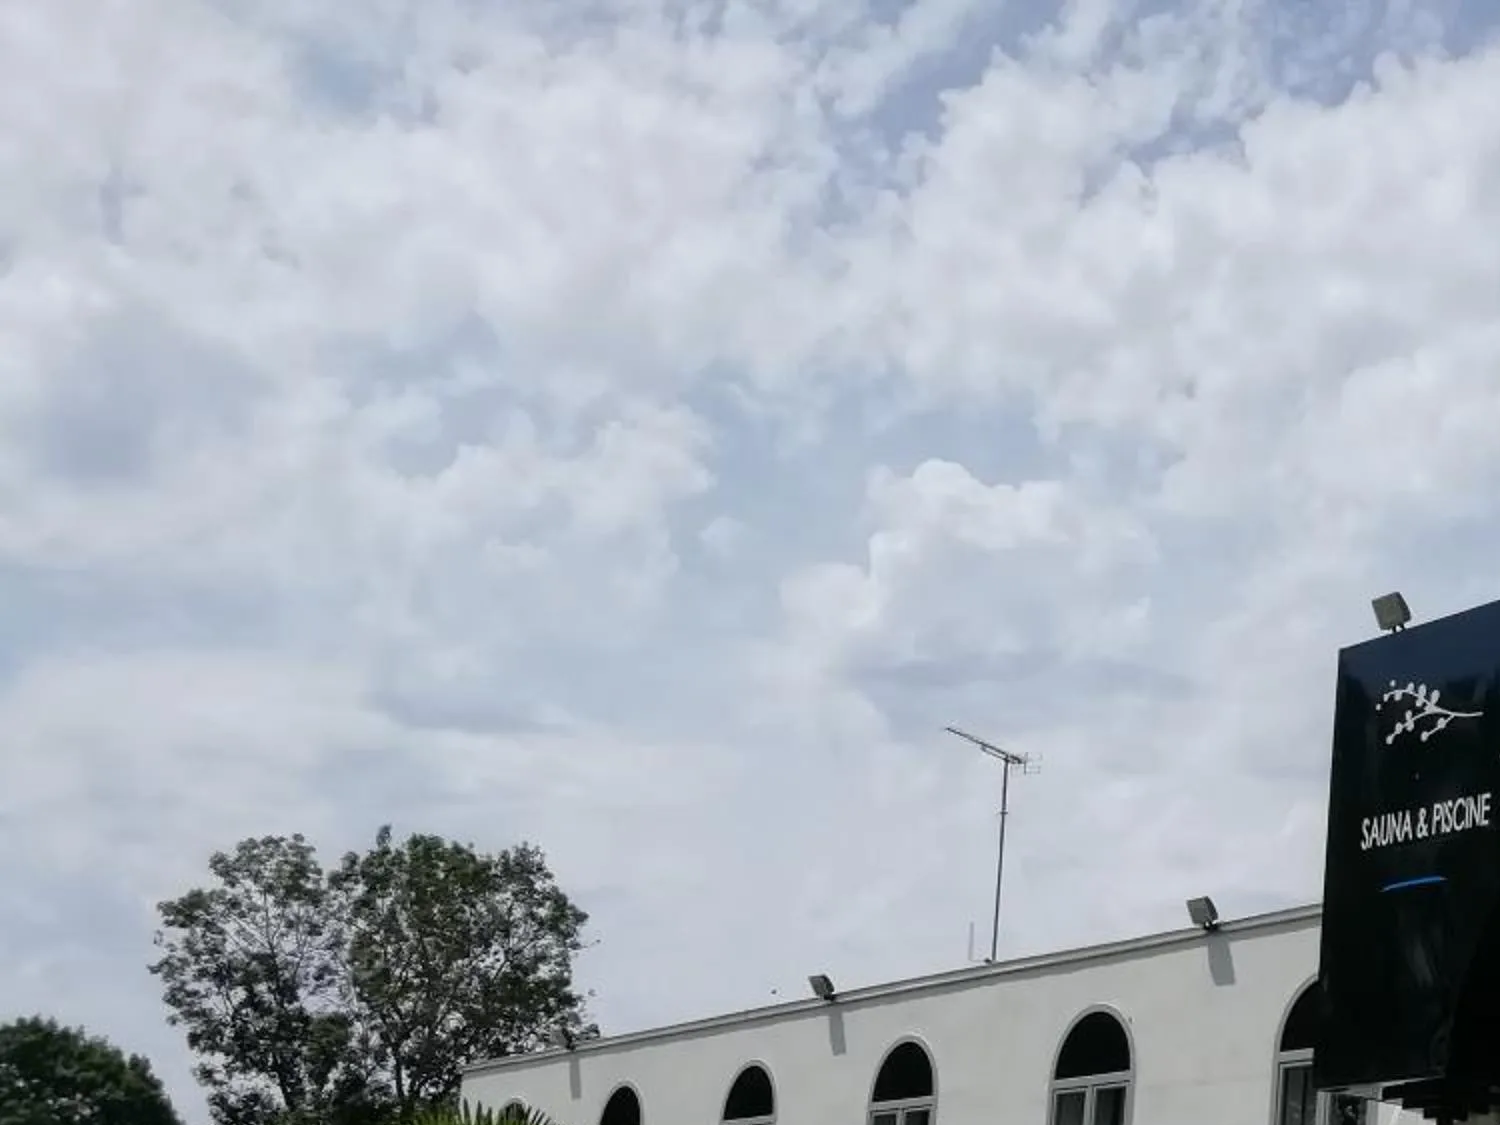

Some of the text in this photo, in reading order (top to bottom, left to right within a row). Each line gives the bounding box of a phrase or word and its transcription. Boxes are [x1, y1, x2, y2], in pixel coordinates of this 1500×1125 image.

[1361, 792, 1492, 851] SAUNA & PISCINE
